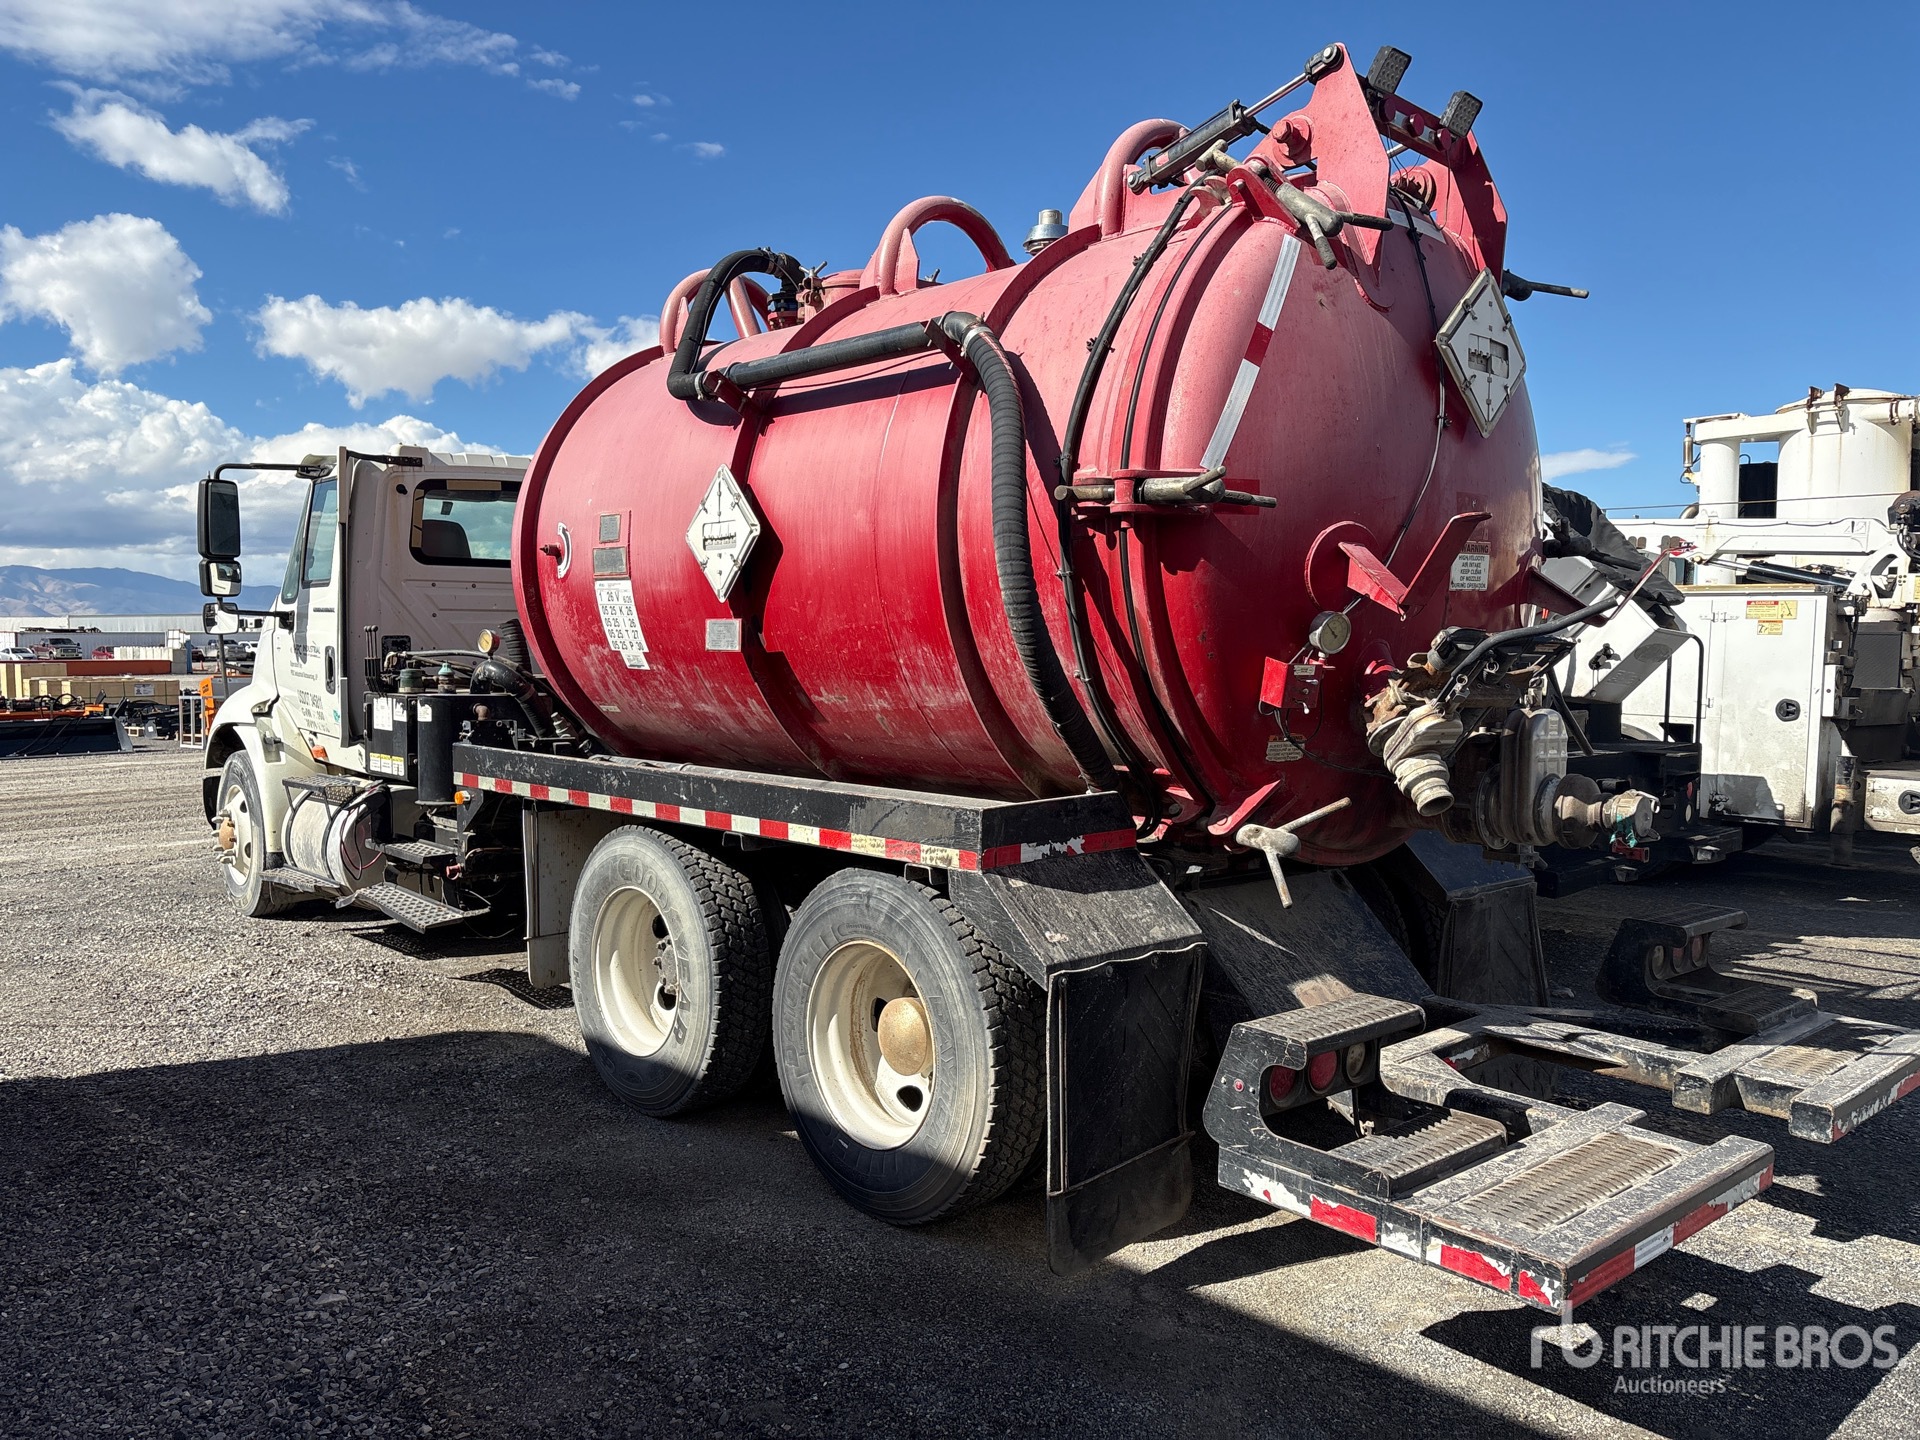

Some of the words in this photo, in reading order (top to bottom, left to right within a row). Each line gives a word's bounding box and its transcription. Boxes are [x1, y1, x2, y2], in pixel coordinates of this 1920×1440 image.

[615, 591, 620, 602] V
[602, 606, 609, 615] 05
[609, 606, 617, 615] 25
[618, 606, 624, 616] K
[605, 618, 612, 627] 05
[612, 618, 620, 627] 25
[608, 629, 616, 638] 05
[616, 629, 624, 638] 25
[625, 630, 630, 639] T
[612, 641, 620, 650] 05
[620, 641, 628, 650] 25
[629, 641, 634, 650] P
[617, 856, 693, 1046] GOODYEAR
